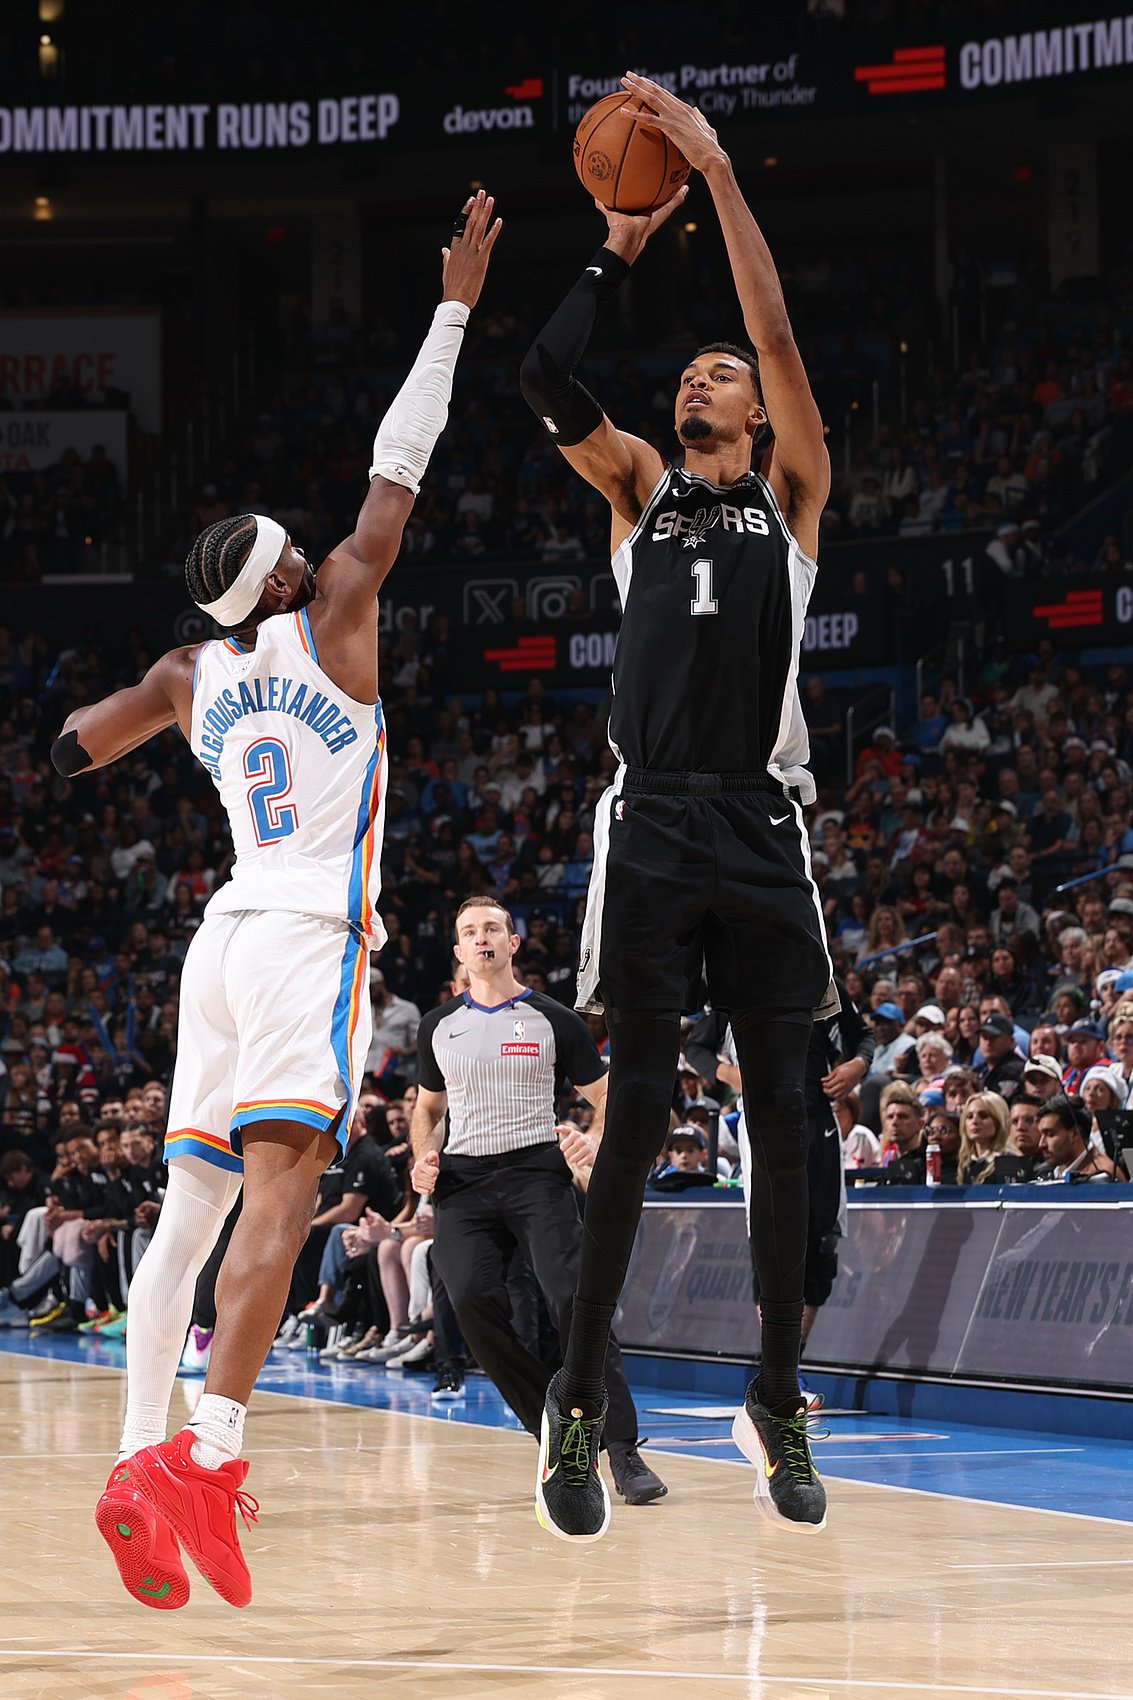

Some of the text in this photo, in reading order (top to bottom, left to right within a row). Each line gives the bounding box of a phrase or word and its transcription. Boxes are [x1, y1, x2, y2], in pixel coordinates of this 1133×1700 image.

[679, 62, 771, 90] Partner
[772, 52, 799, 83] of
[700, 83, 818, 116] City Thunder
[216, 100, 311, 150] RUNS
[316, 92, 400, 146] DEEP
[442, 104, 535, 134] devon
[7, 420, 51, 448] OAK
[690, 558, 718, 615] 1
[569, 611, 859, 669] COM DEEP
[243, 736, 299, 847] 2
[502, 1044, 539, 1054] Emirates
